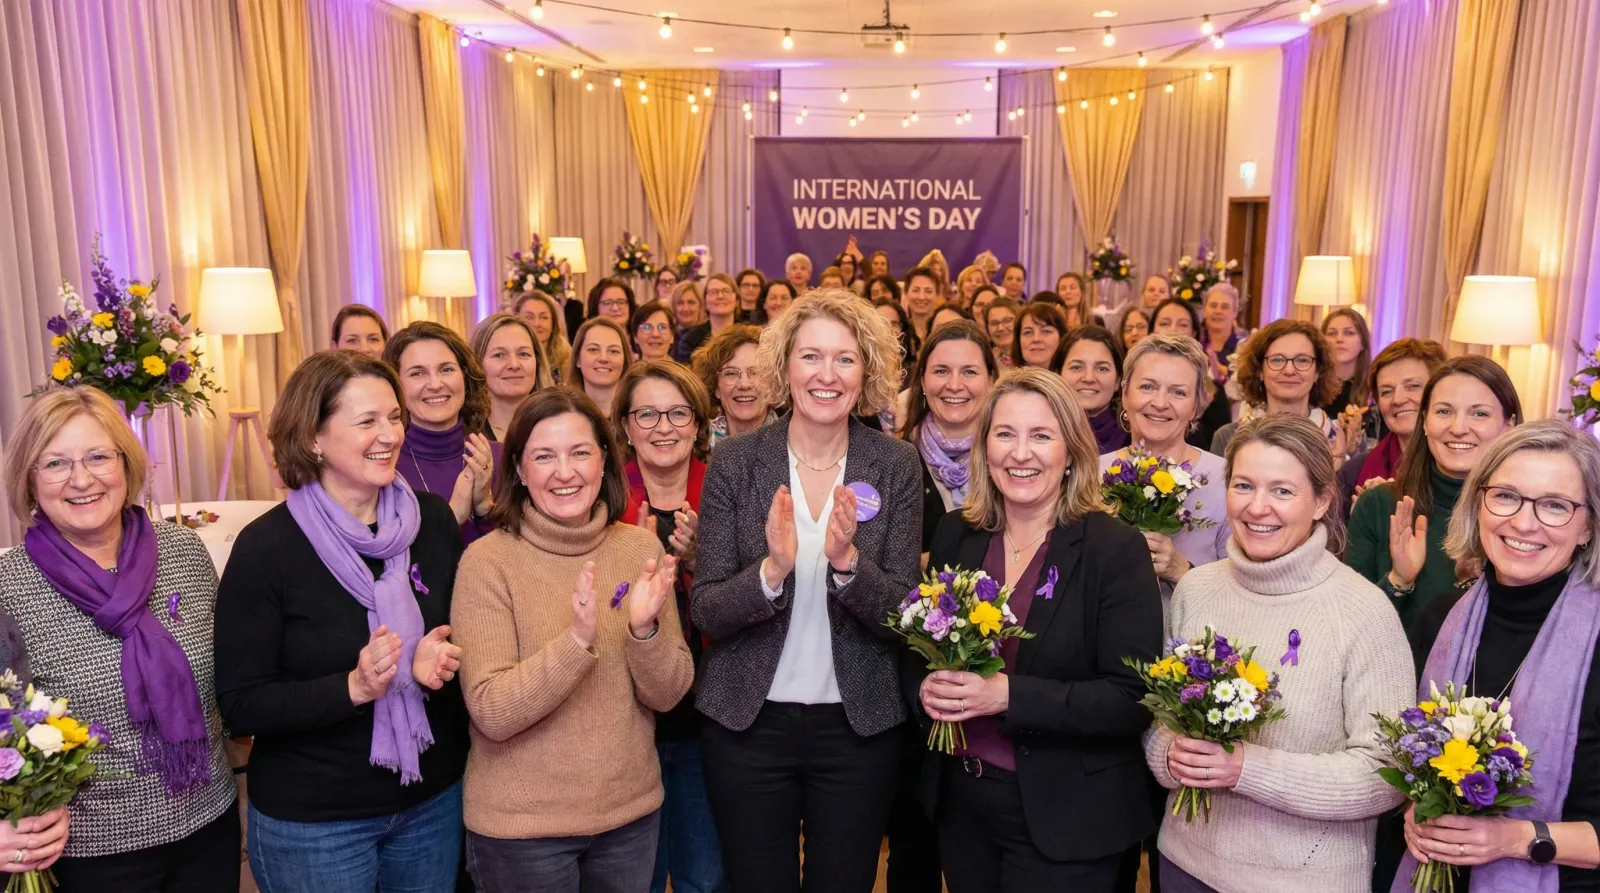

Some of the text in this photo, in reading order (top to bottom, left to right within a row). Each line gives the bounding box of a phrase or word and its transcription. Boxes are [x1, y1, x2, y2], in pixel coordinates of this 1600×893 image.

[793, 178, 982, 200] INTERNATIONAL
[792, 206, 982, 230] WOMEN’S DAY
